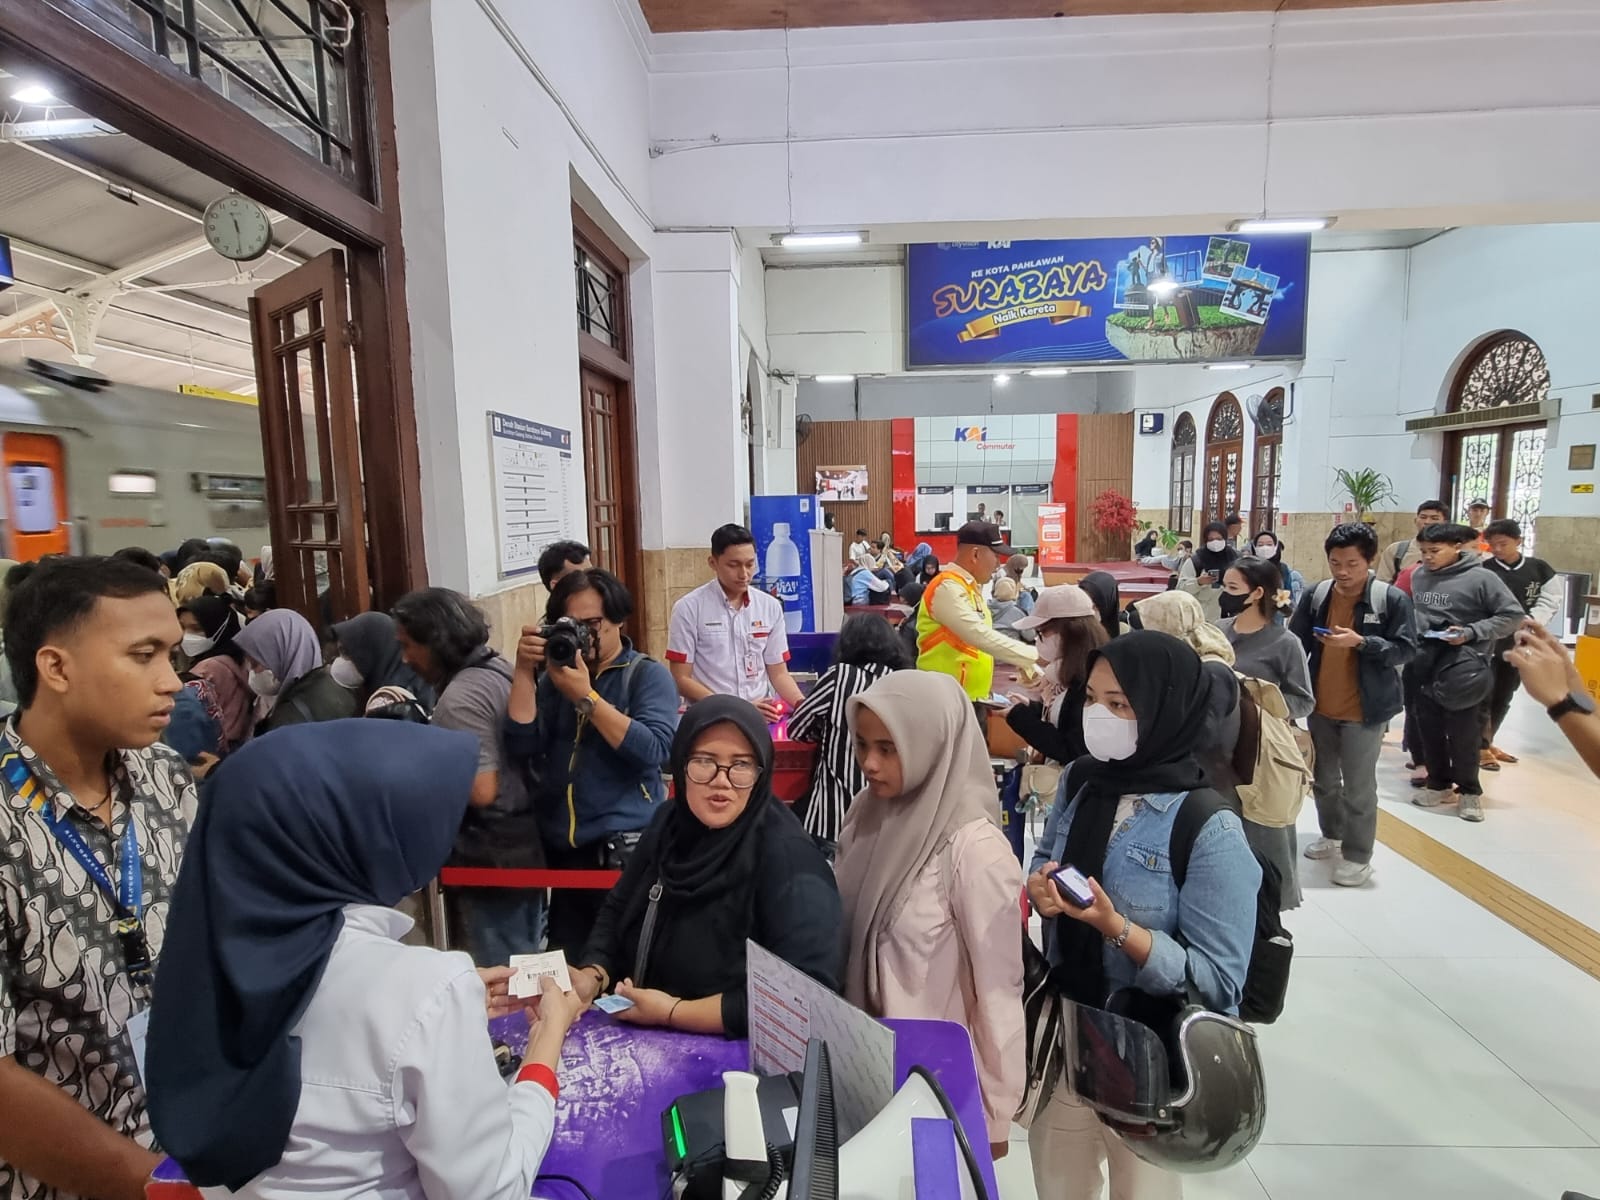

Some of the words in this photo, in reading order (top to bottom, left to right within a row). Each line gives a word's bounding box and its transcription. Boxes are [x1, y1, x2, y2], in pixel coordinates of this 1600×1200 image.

[971, 270, 983, 279] KE
[985, 265, 1010, 276] KOTA
[1011, 255, 1064, 271] PAHLAWAN
[932, 260, 1108, 318] SURABAYA
[992, 311, 1019, 326] Naik
[1019, 304, 1057, 319] Kereta
